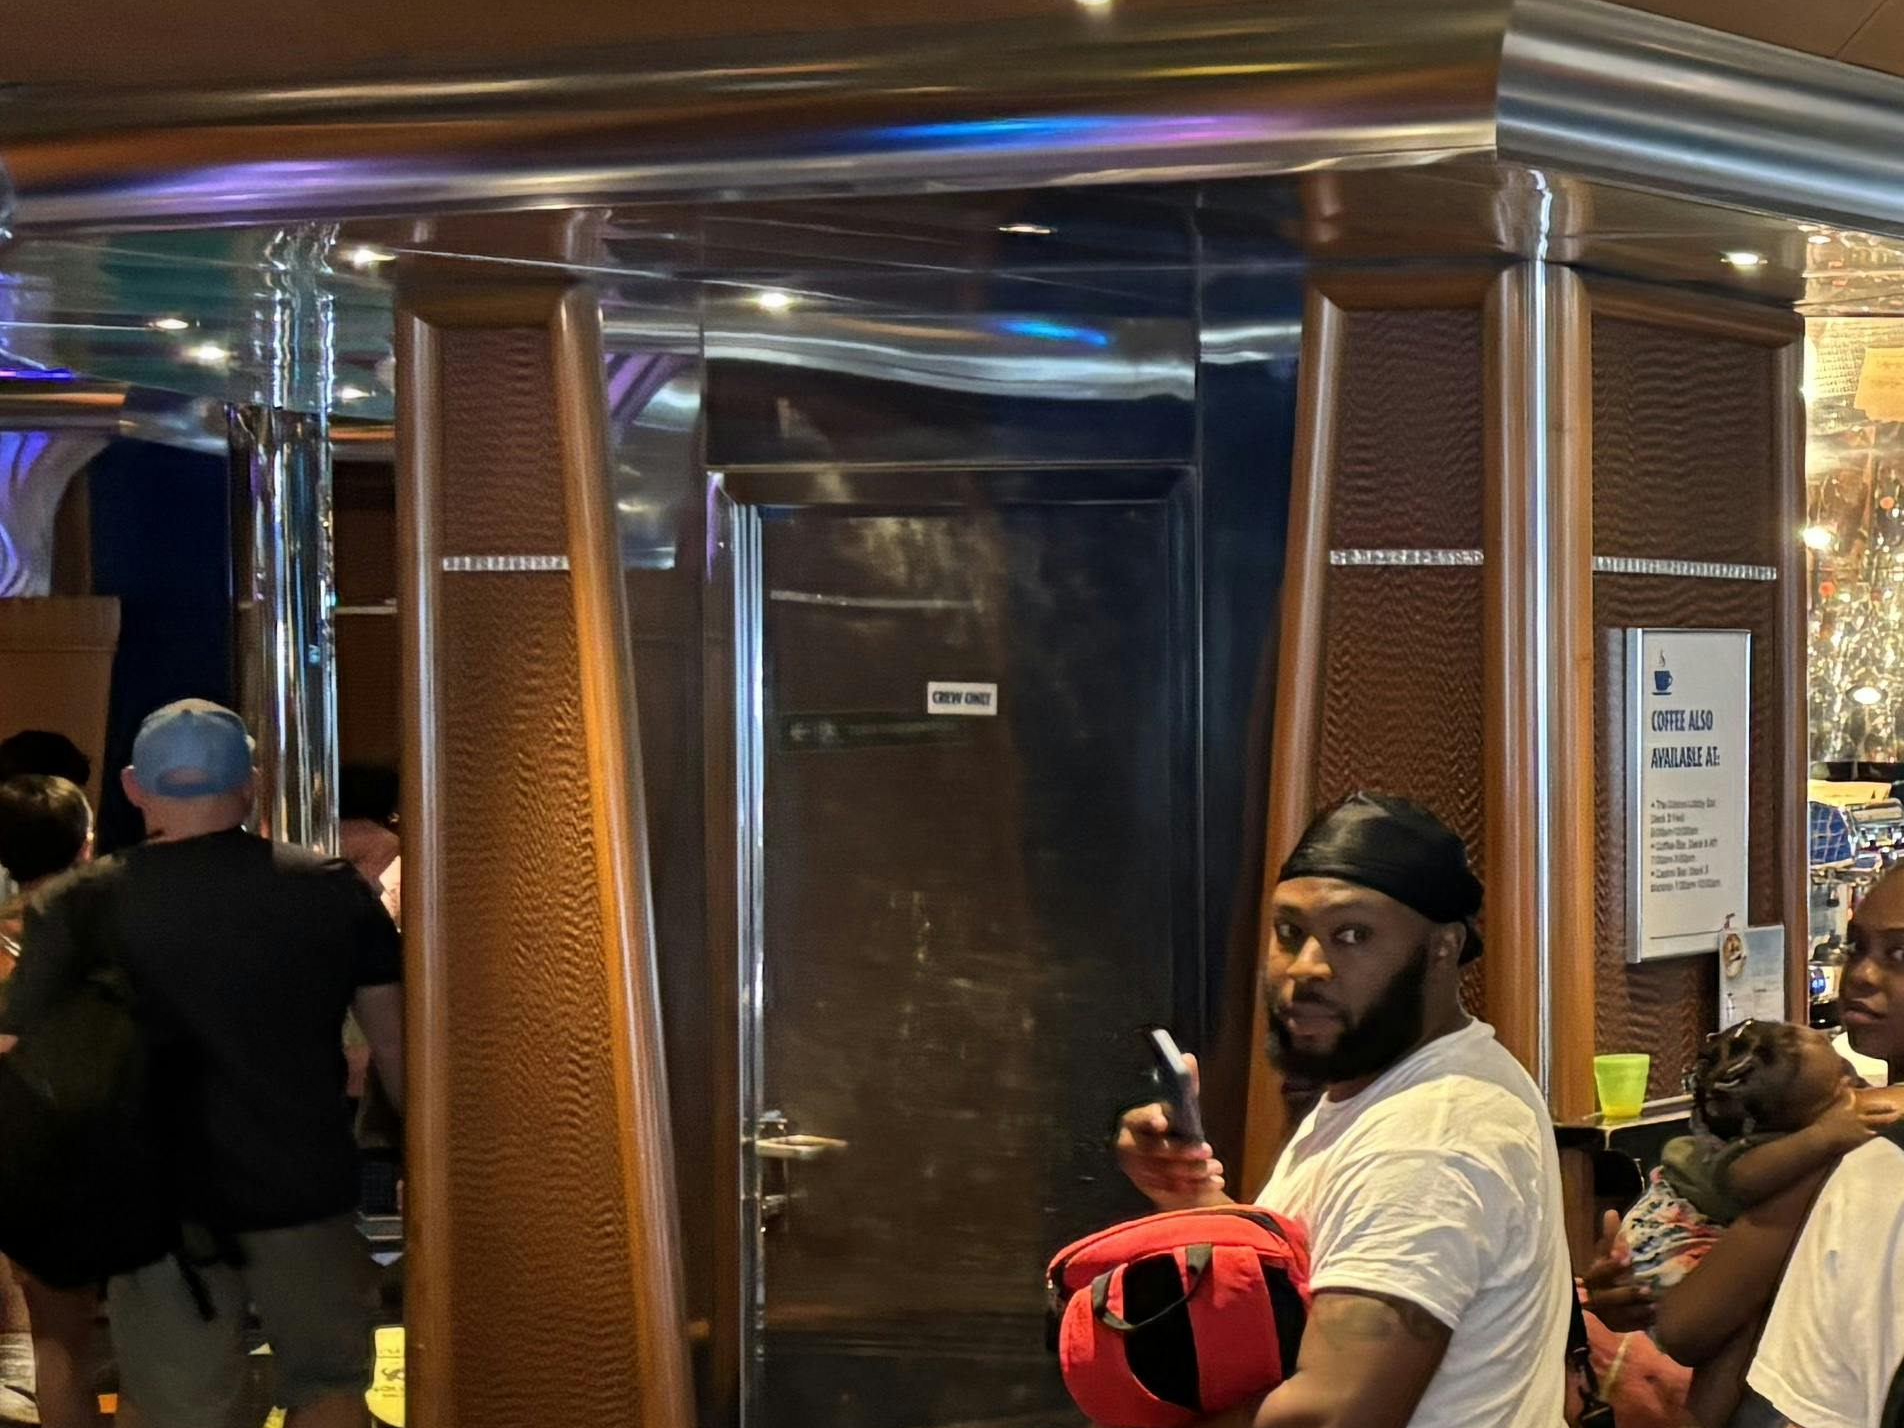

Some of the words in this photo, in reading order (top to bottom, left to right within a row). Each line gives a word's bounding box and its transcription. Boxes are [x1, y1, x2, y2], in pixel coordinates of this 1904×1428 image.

[932, 690, 962, 705] CREW
[1651, 709, 1686, 732] COFFEE
[1688, 709, 1714, 732] ALSO
[1650, 746, 1703, 769] AVAILABLE
